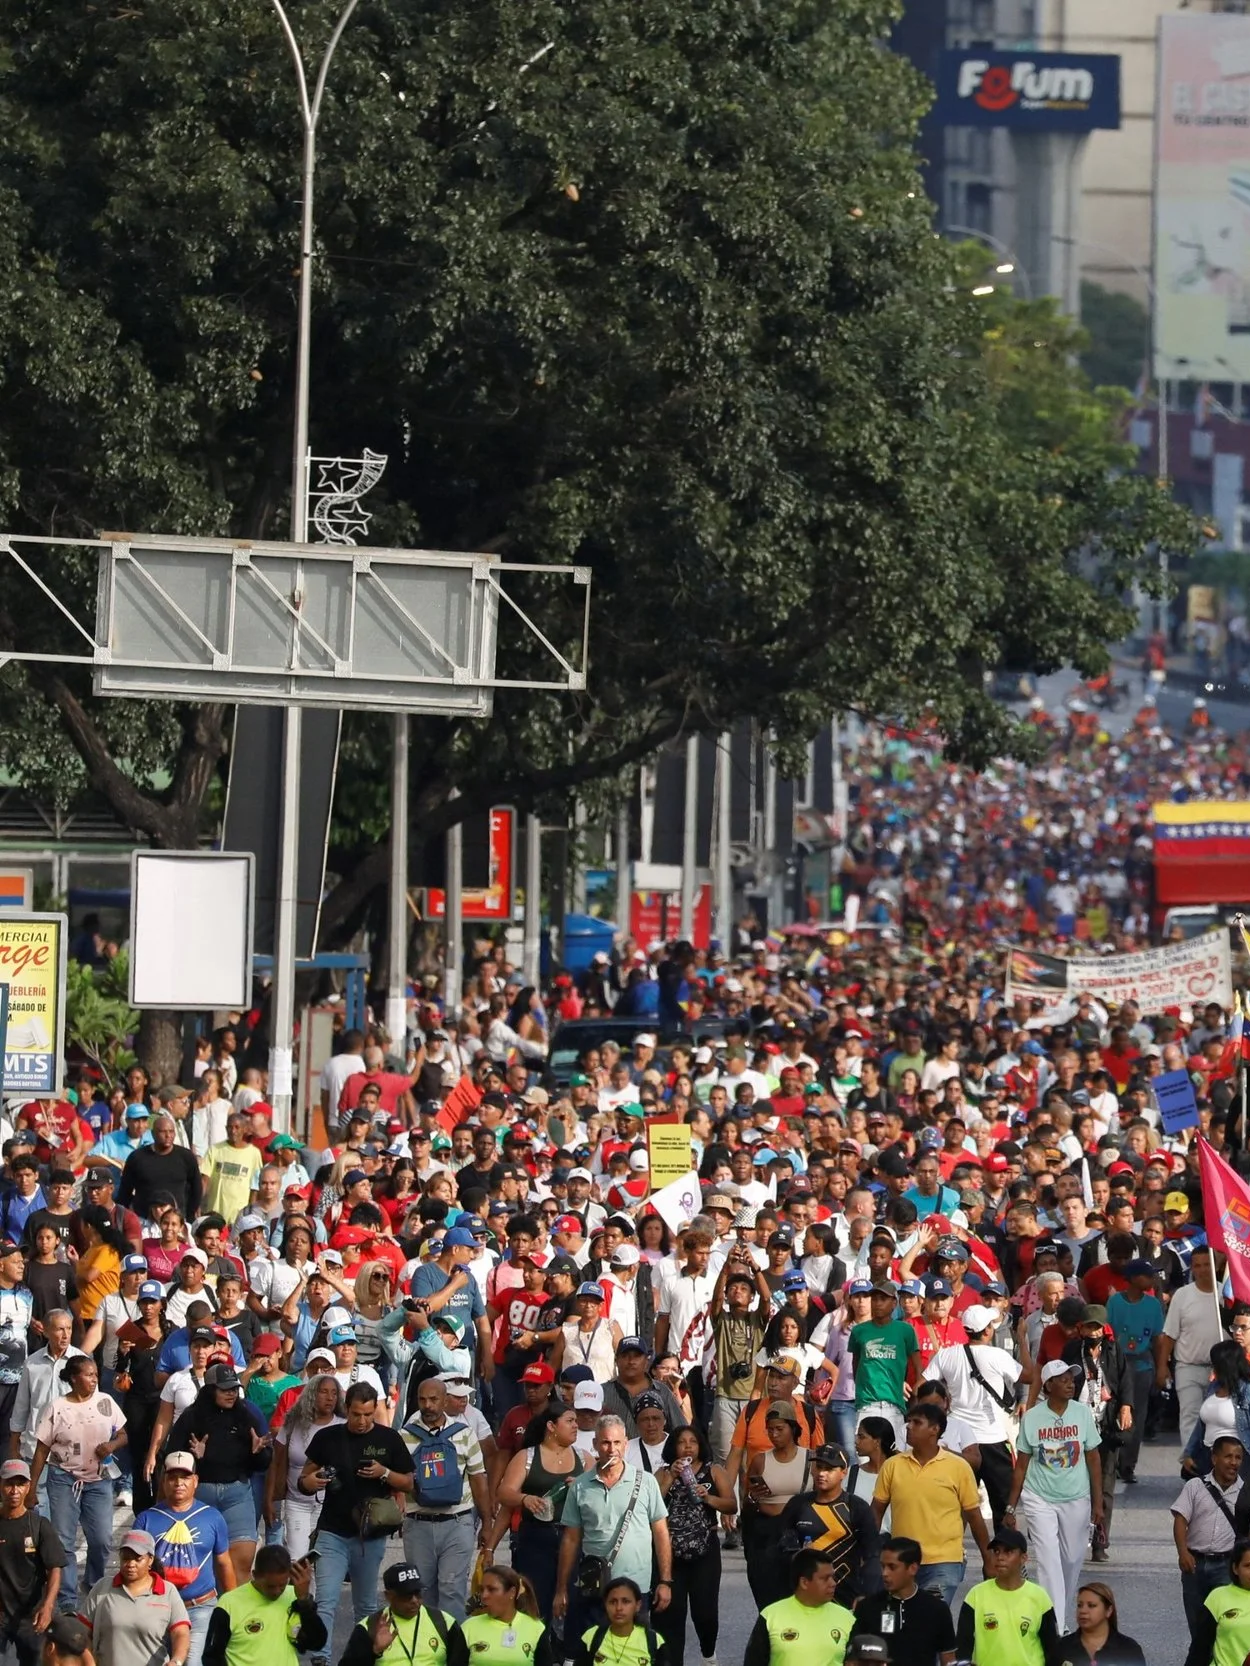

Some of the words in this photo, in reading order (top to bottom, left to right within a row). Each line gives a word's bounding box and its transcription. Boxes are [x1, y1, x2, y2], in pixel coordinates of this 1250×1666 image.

[958, 60, 1094, 106] Forum
[38, 1003, 46, 1012] DE
[510, 1301, 542, 1329] 80
[866, 1350, 897, 1360] LACOSTE
[1038, 1425, 1079, 1441] MADURO
